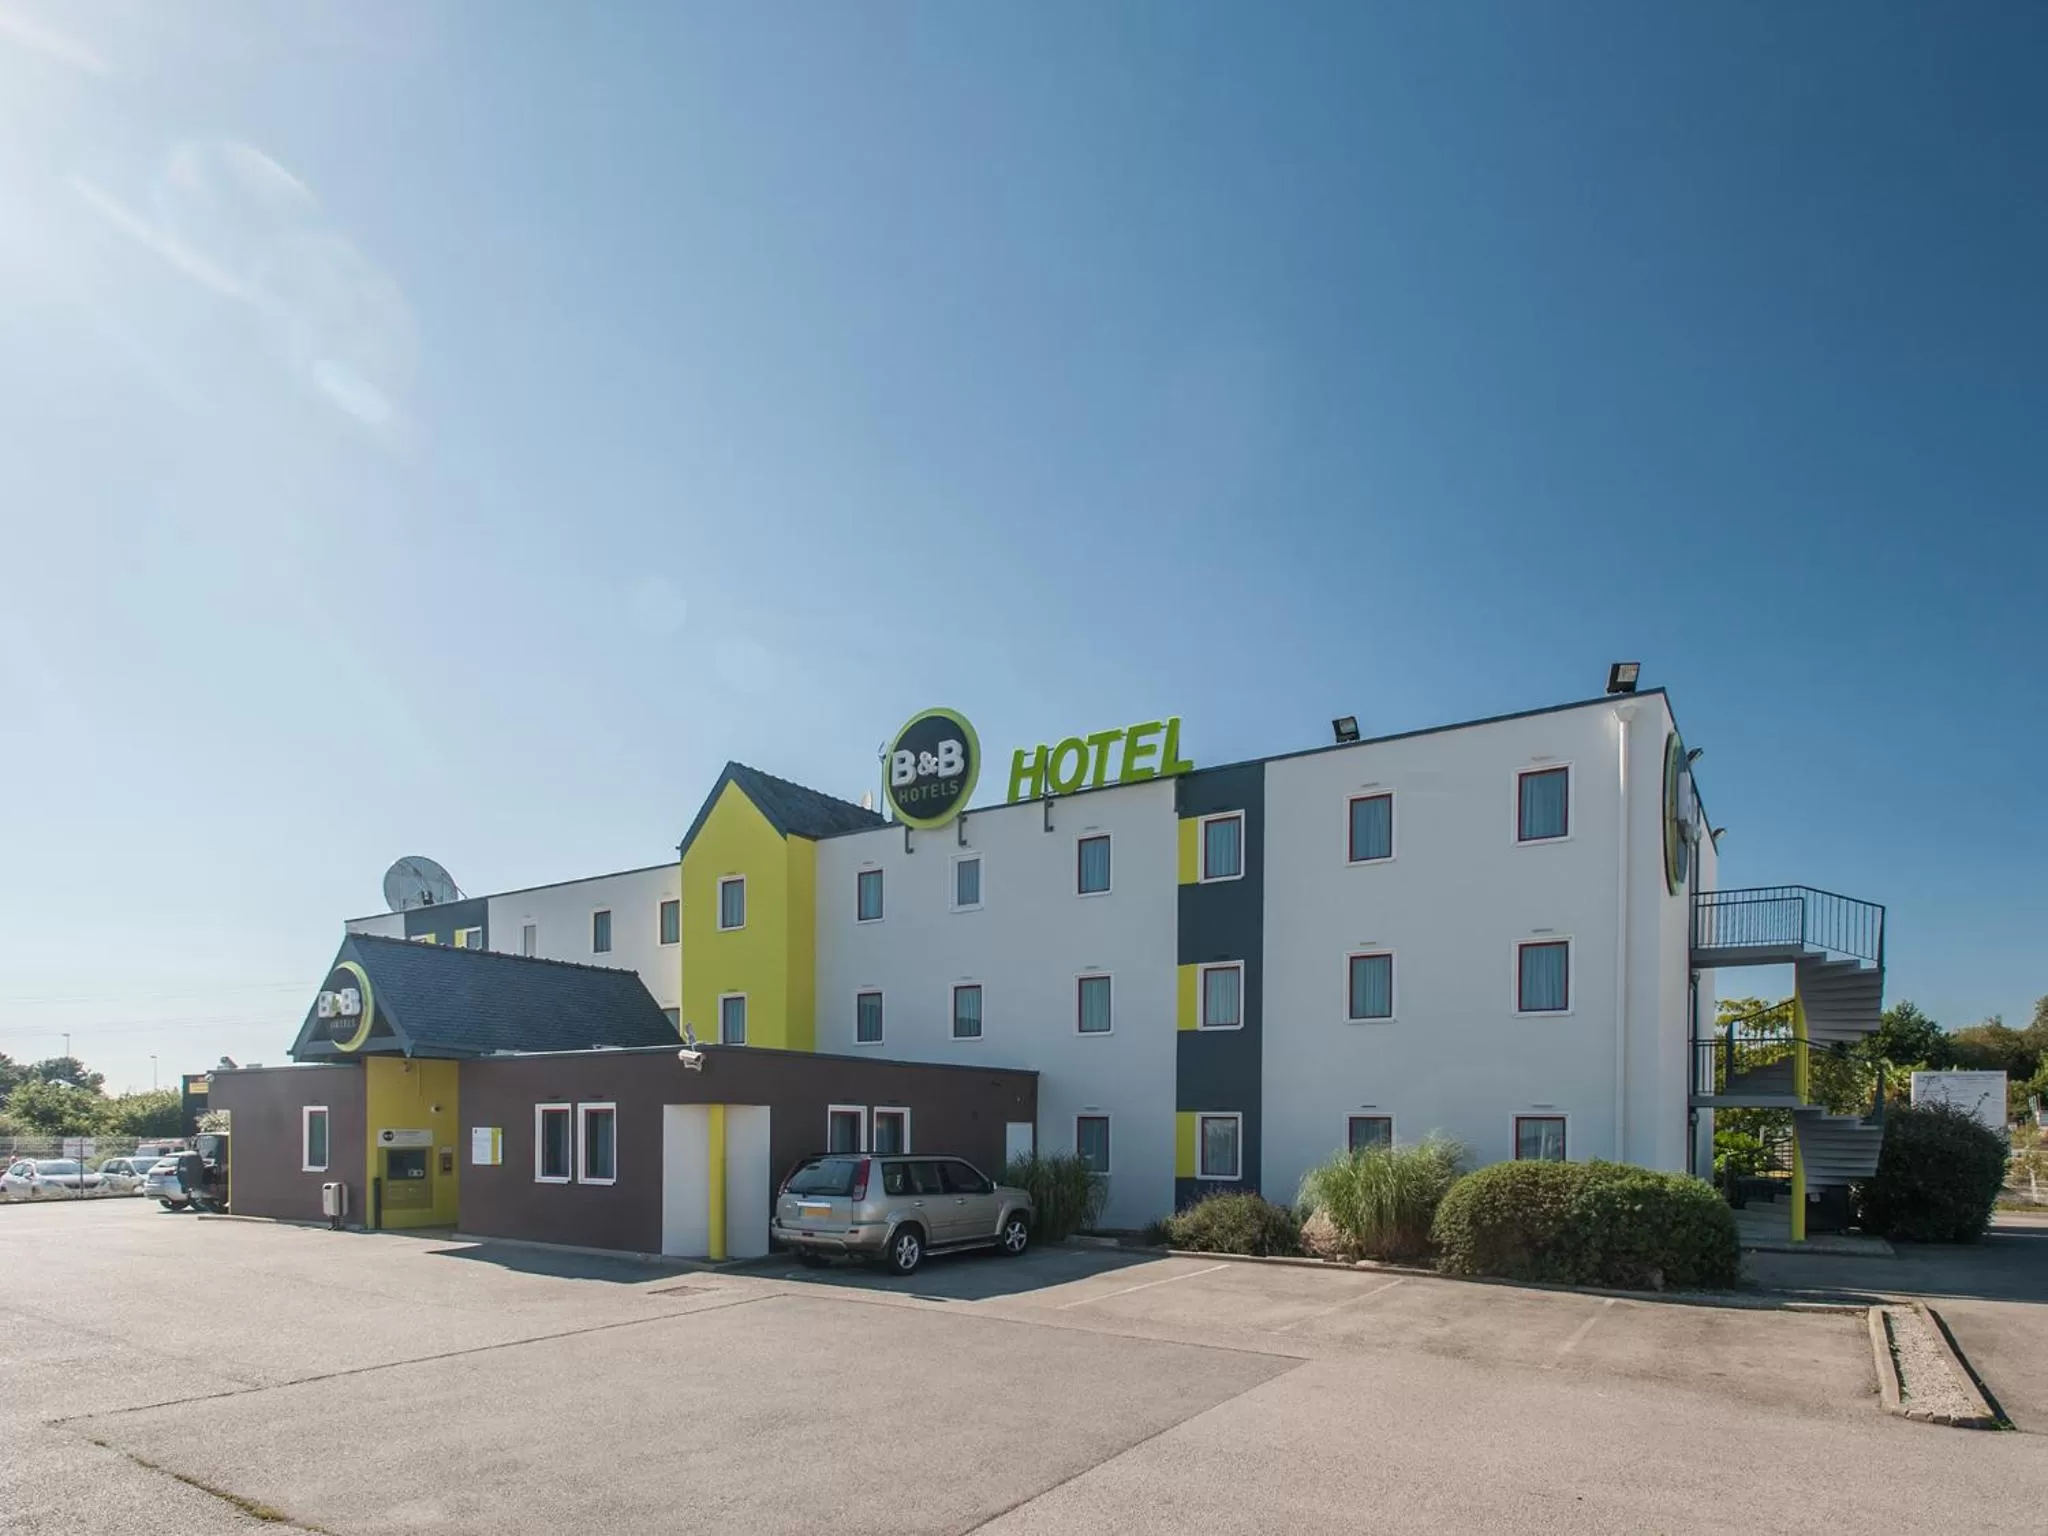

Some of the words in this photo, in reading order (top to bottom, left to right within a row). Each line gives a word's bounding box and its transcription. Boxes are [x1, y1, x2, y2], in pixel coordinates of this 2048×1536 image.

[891, 739, 965, 787] B&B
[1007, 716, 1194, 804] HOTEL
[899, 780, 959, 804] HOTELS
